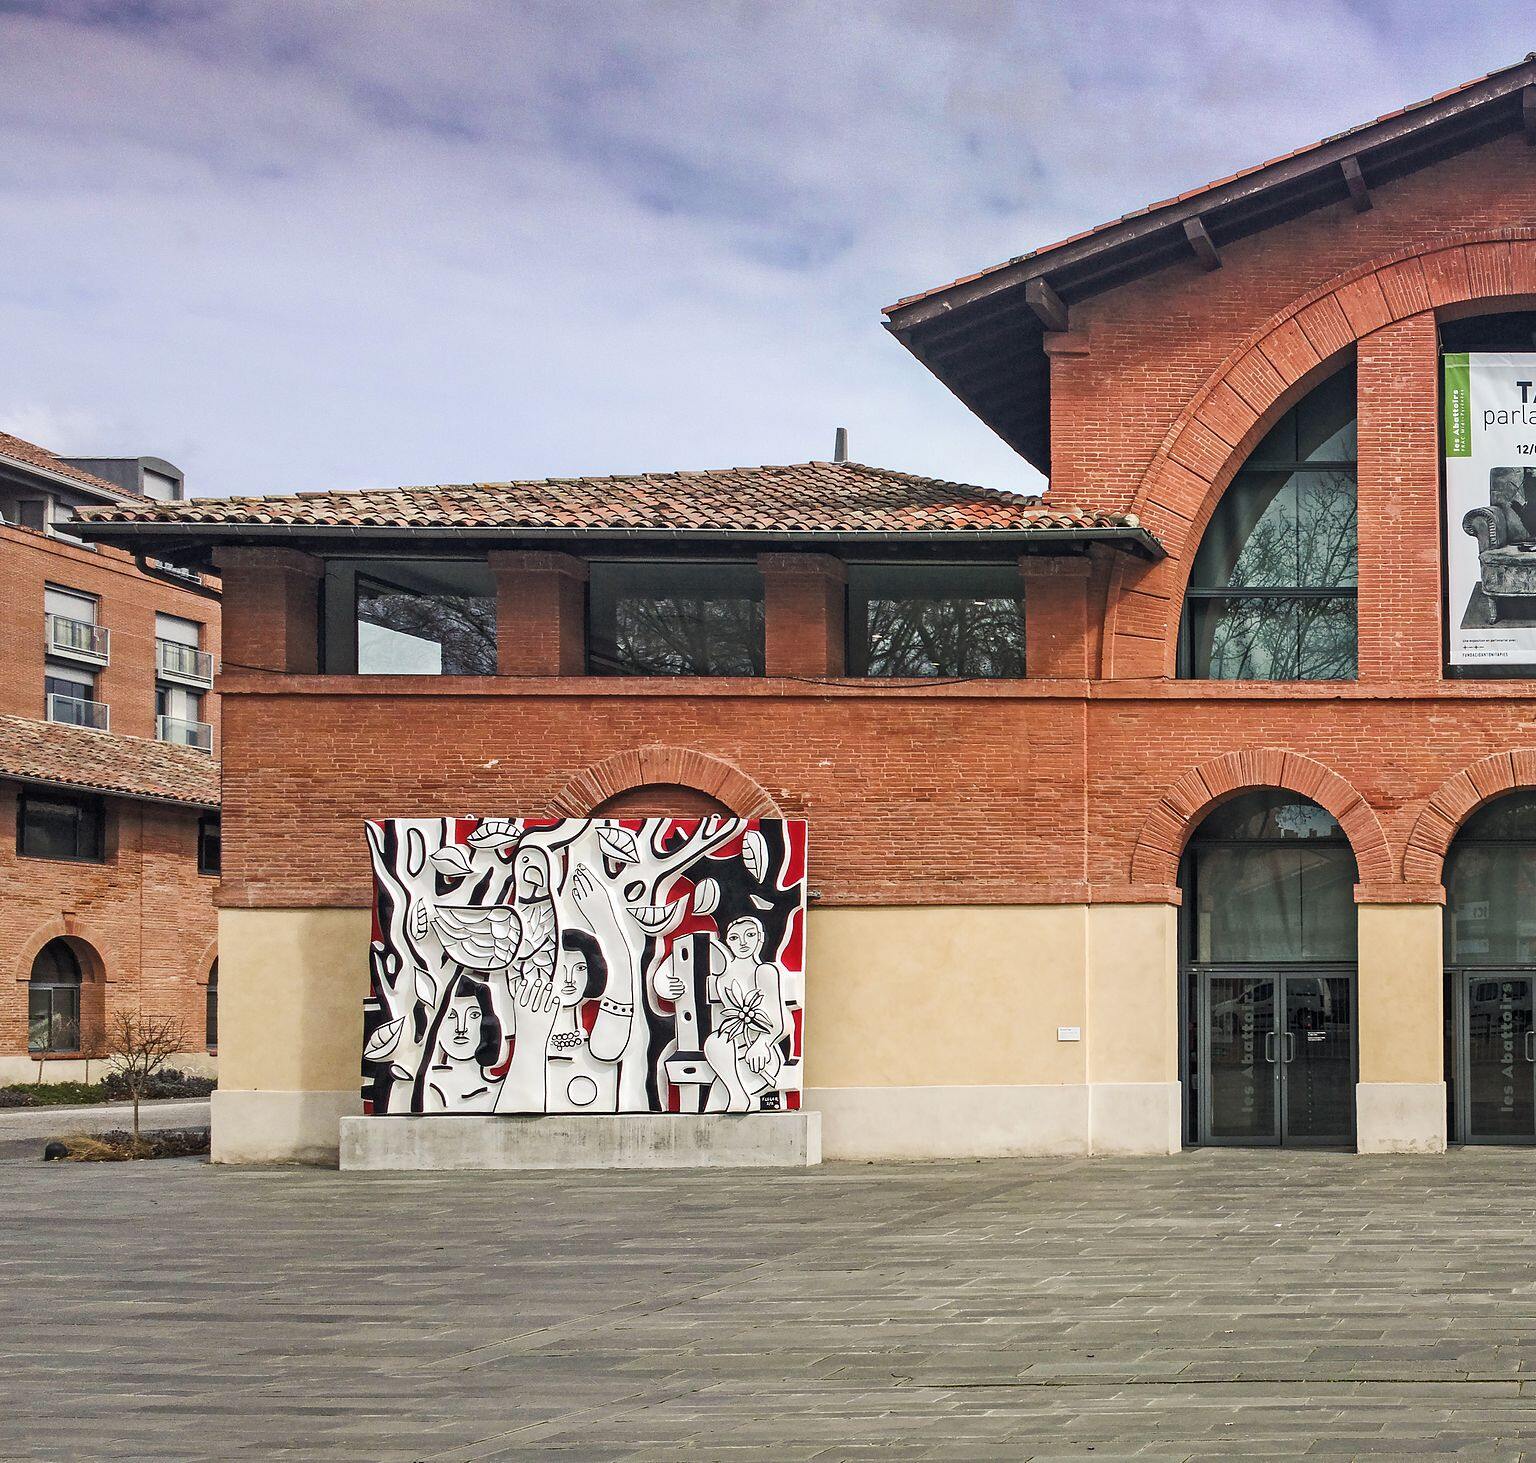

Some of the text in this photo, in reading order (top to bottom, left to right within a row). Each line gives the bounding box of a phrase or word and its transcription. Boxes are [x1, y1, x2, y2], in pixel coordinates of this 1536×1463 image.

[1452, 389, 1460, 435] Abattoirs
[1241, 984, 1254, 1078] Abattoirs
[1499, 983, 1514, 1112] les Abattoirs
